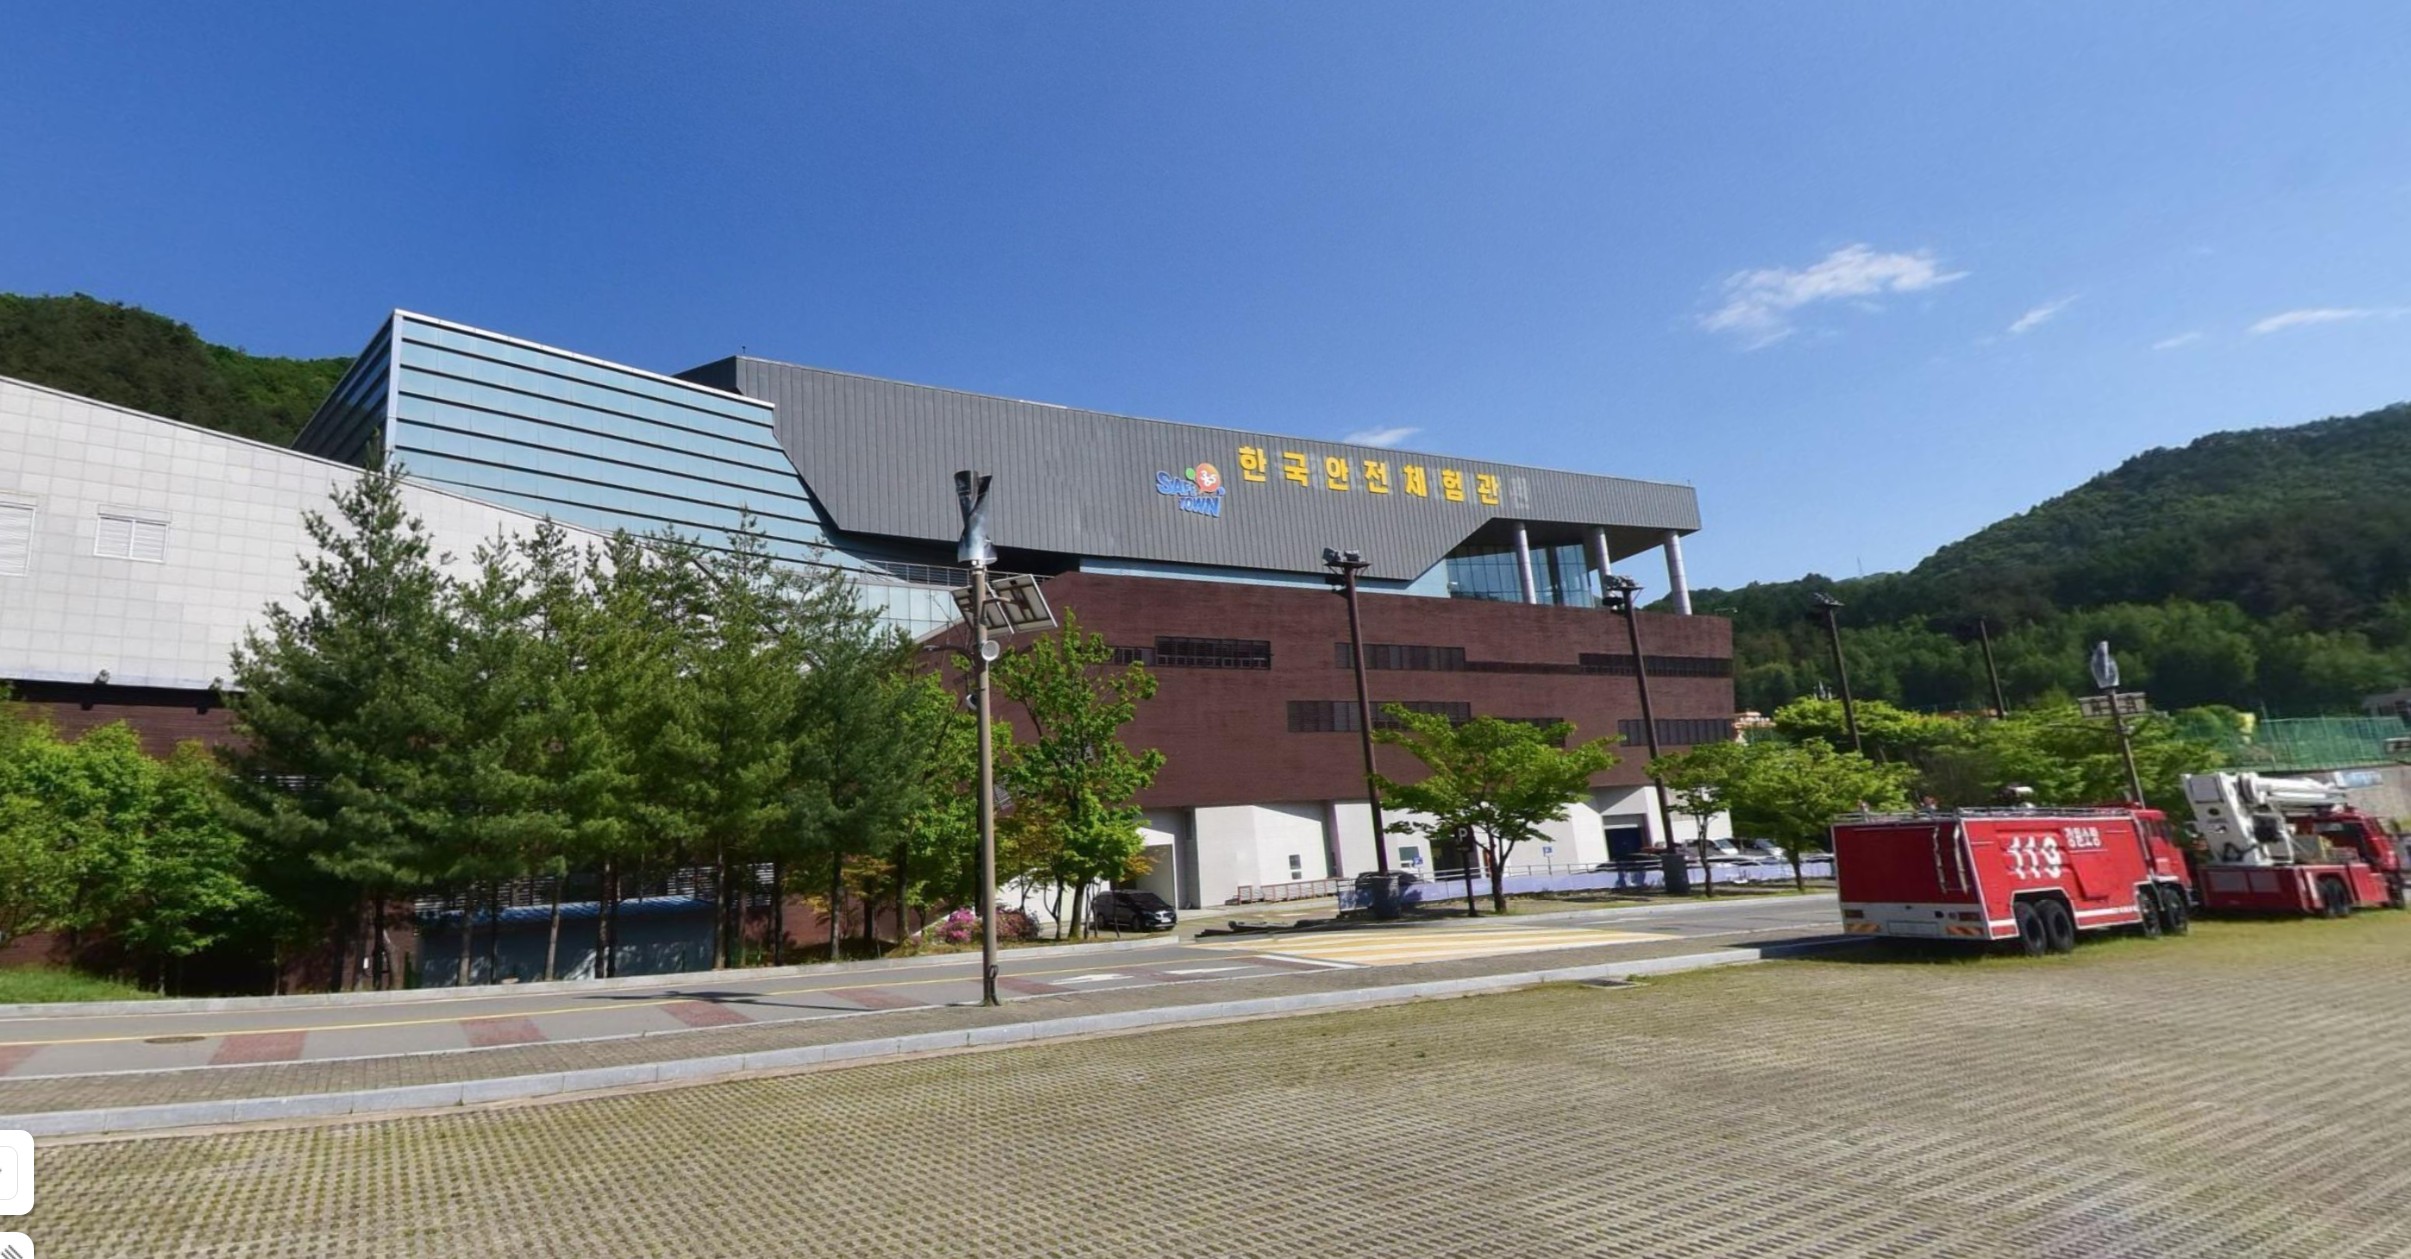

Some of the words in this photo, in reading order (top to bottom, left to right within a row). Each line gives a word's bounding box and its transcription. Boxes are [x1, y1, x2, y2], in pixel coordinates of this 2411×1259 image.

[1238, 446, 1500, 504] 한국안전체험관
[1179, 496, 1220, 518] TOWN
[1458, 828, 1468, 842] P
